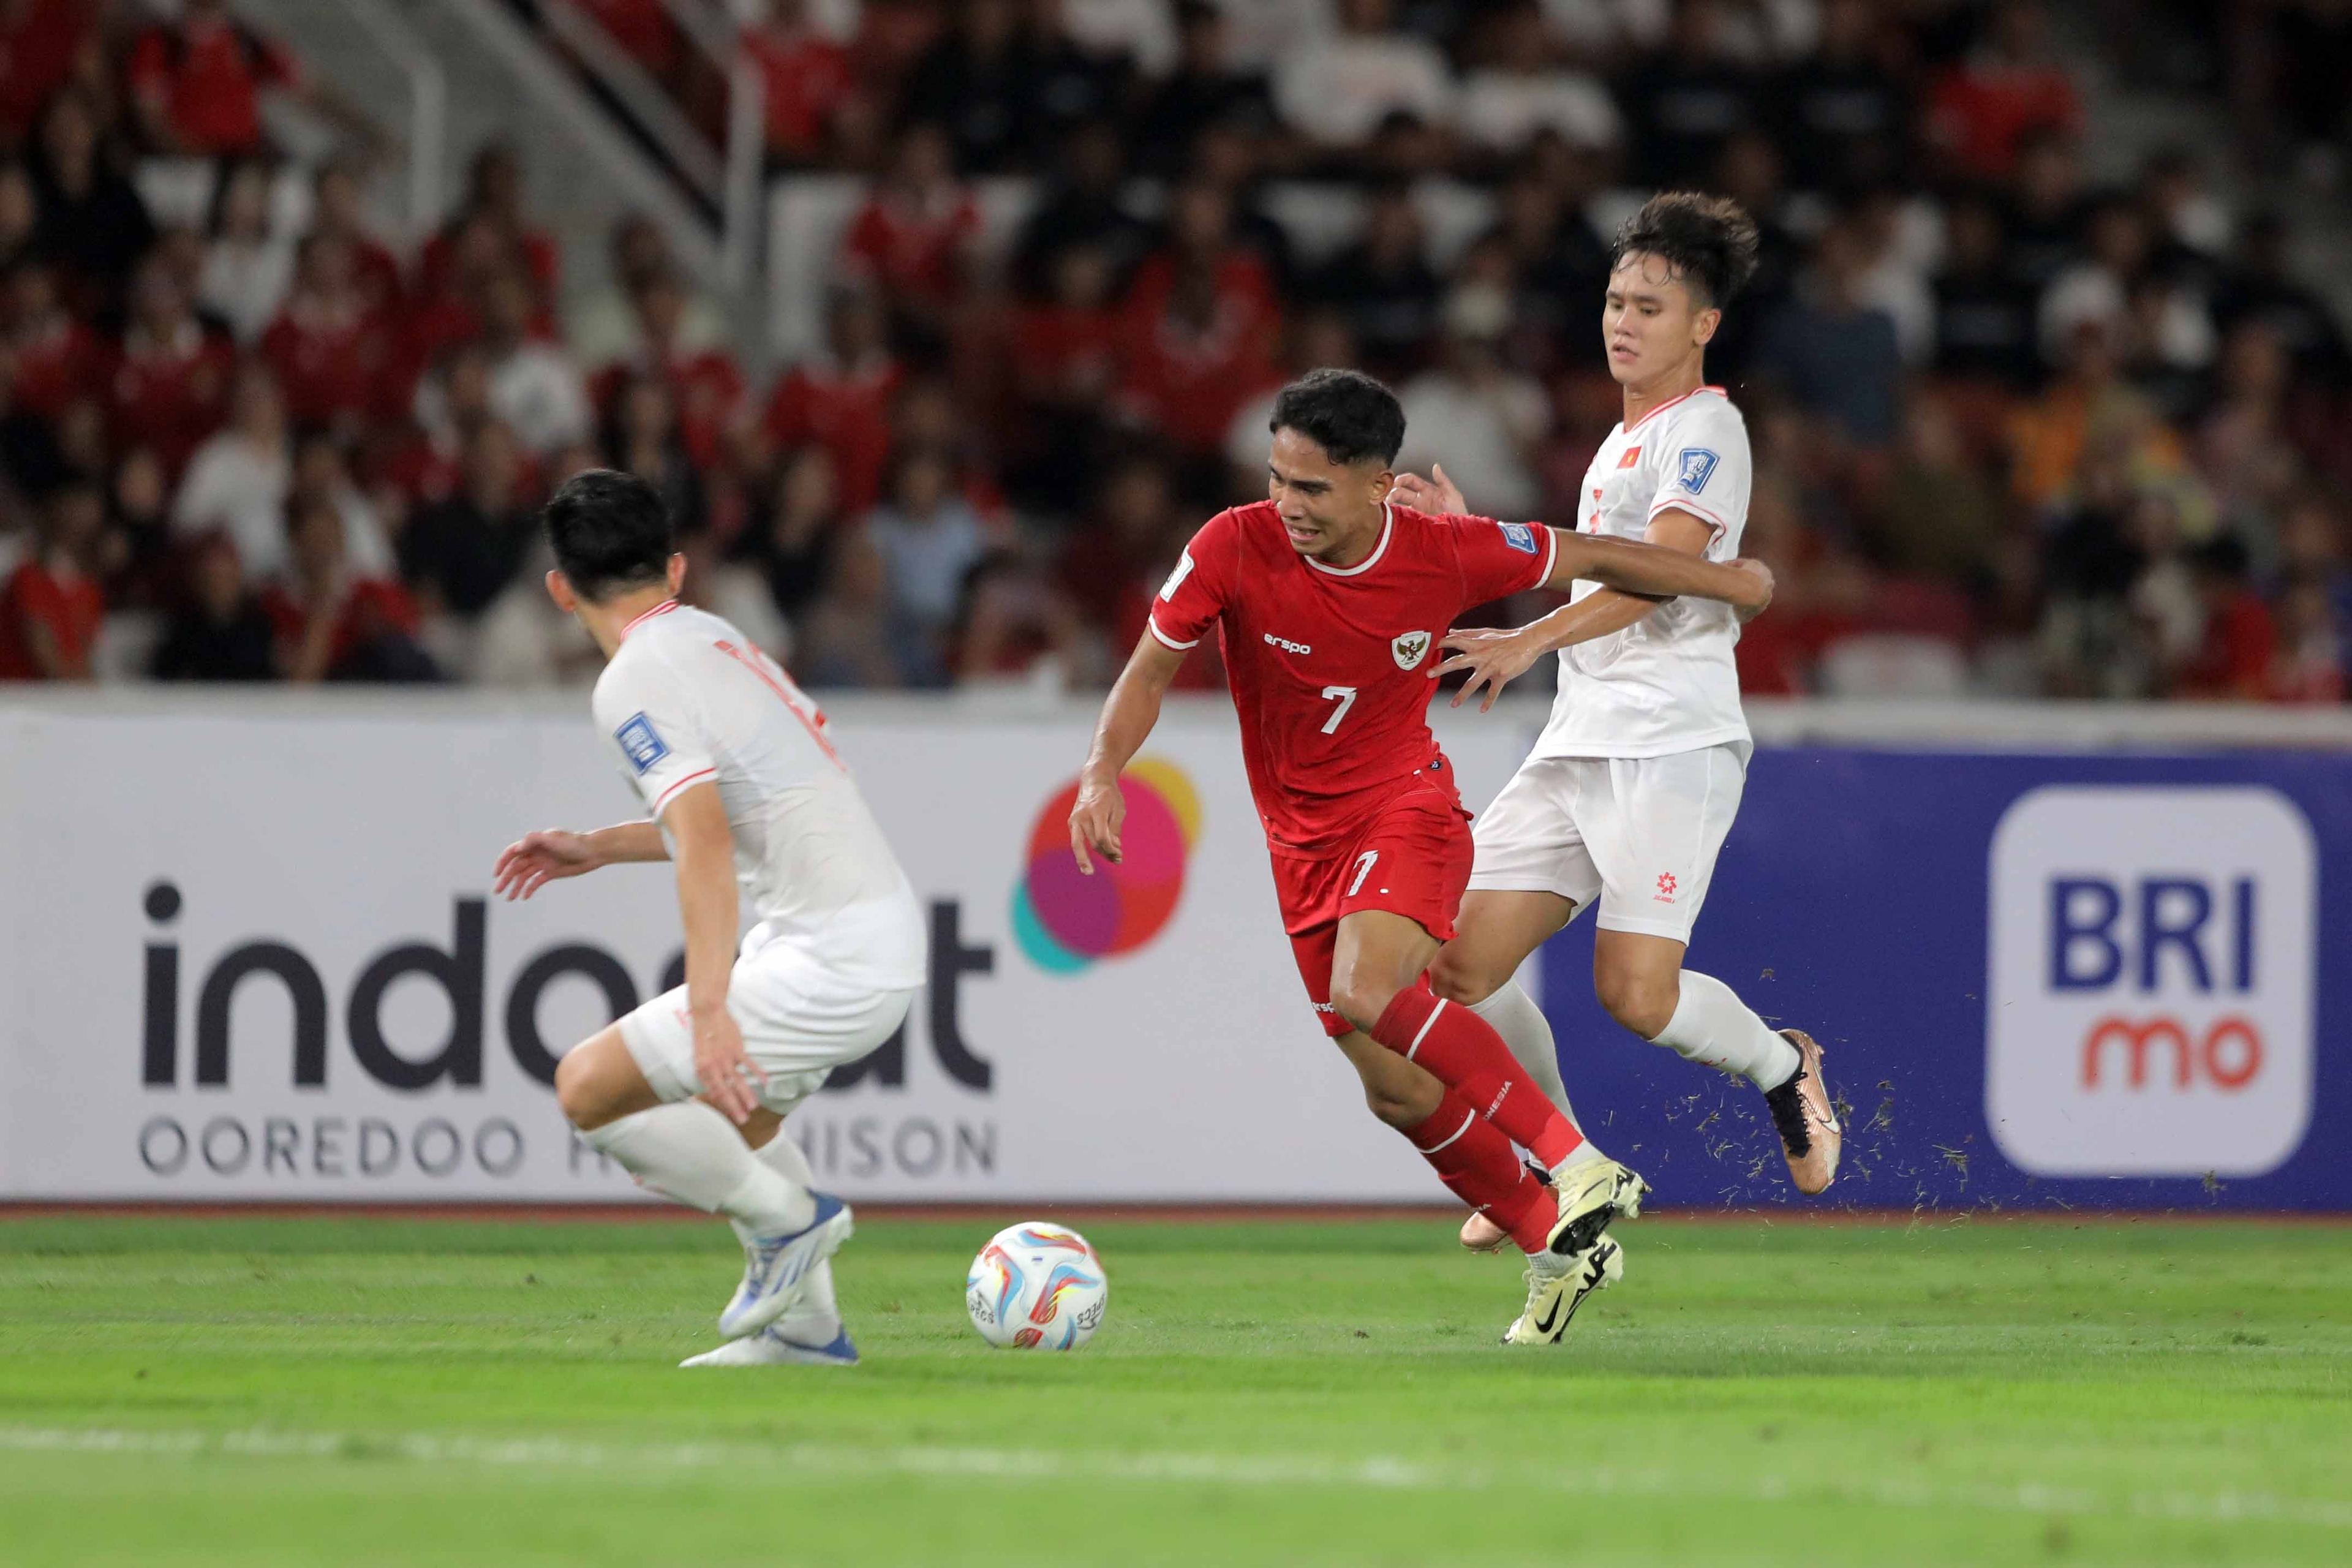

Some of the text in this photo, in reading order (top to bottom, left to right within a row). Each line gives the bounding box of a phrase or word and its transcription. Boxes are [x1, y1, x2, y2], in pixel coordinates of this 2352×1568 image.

[1264, 633, 1311, 655] erspo
[1320, 685, 1357, 734] 7
[1348, 850, 1379, 897] 7
[2048, 876, 2256, 993] BRI
[142, 880, 995, 1093] indot
[2080, 1014, 2263, 1093] mo
[138, 1115, 526, 1177] OOREDOO
